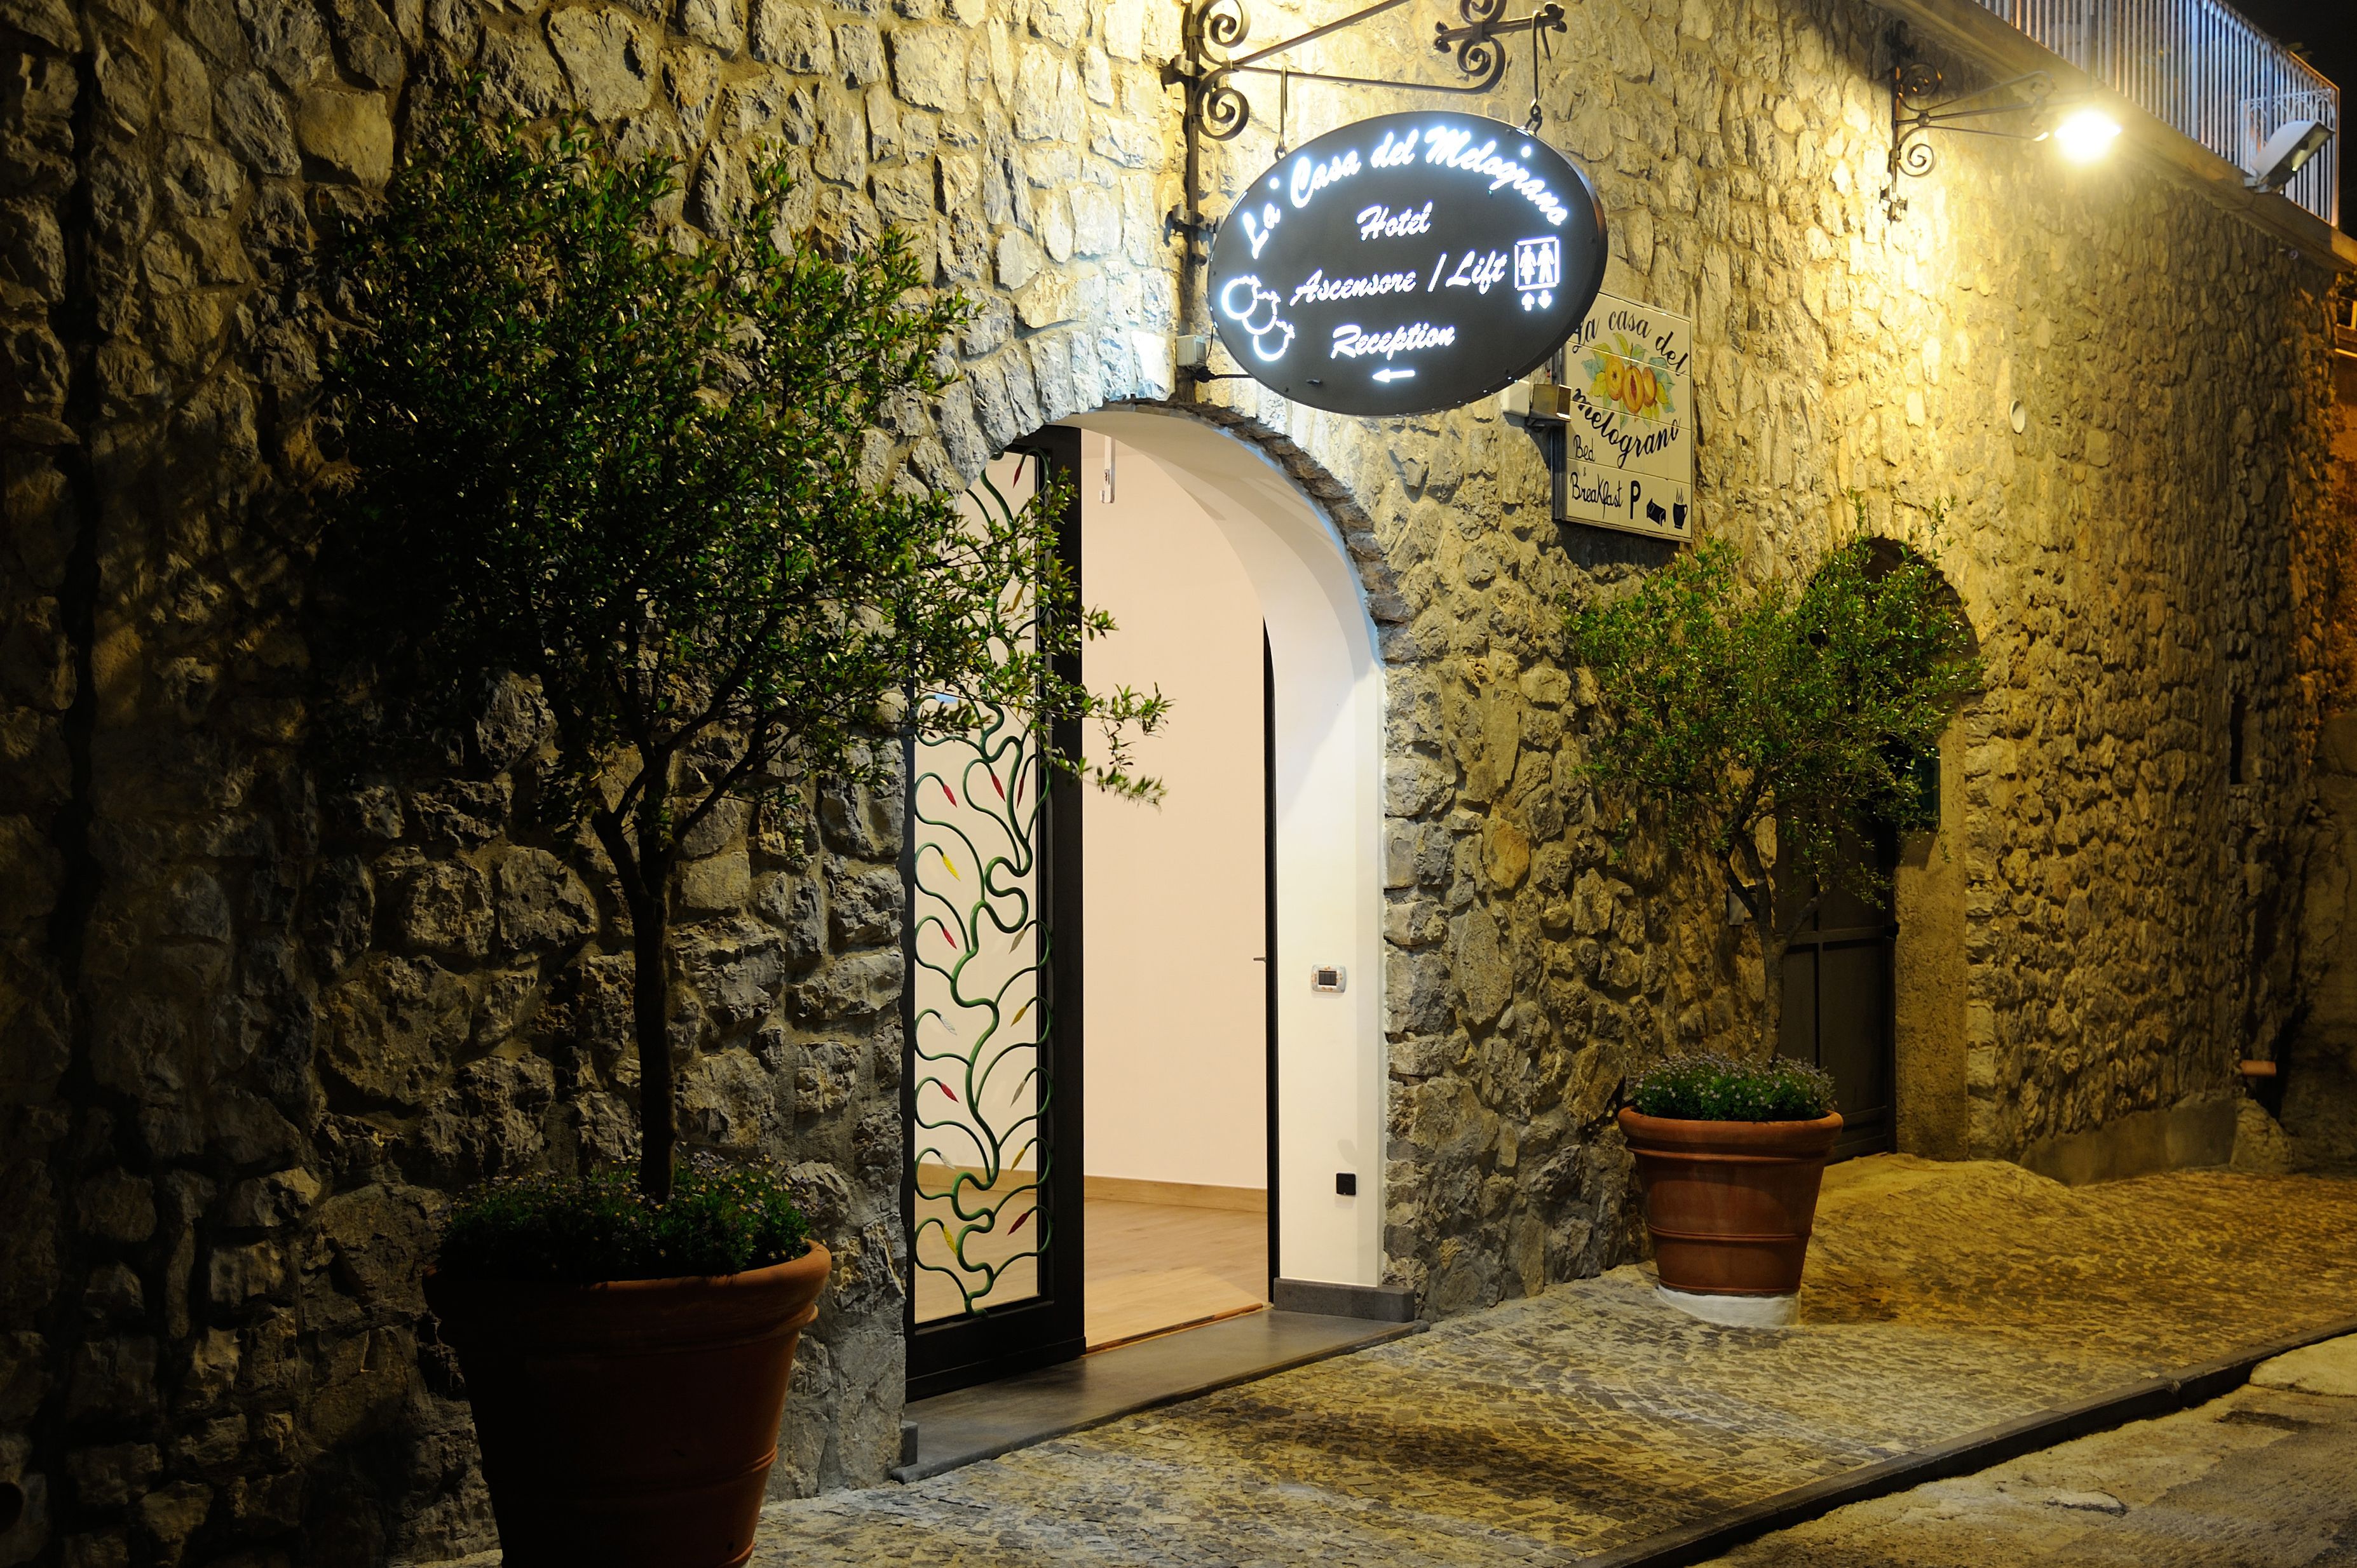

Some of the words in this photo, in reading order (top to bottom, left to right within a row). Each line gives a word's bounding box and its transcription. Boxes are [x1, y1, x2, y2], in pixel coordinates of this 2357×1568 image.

[1242, 204, 1280, 259] La
[1290, 154, 1362, 208] Casa
[1370, 129, 1418, 169] del
[1424, 126, 1568, 226] Melograno
[1357, 202, 1433, 241] Hotel
[1289, 270, 1416, 306] Ascensore
[1446, 251, 1507, 295] Lift
[1330, 322, 1455, 360] Reception
[1608, 311, 1652, 339] casa
[1655, 331, 1688, 376] del
[1573, 388, 1681, 469] melograno
[1573, 435, 1596, 462] Bed
[1630, 480, 1641, 519] P
